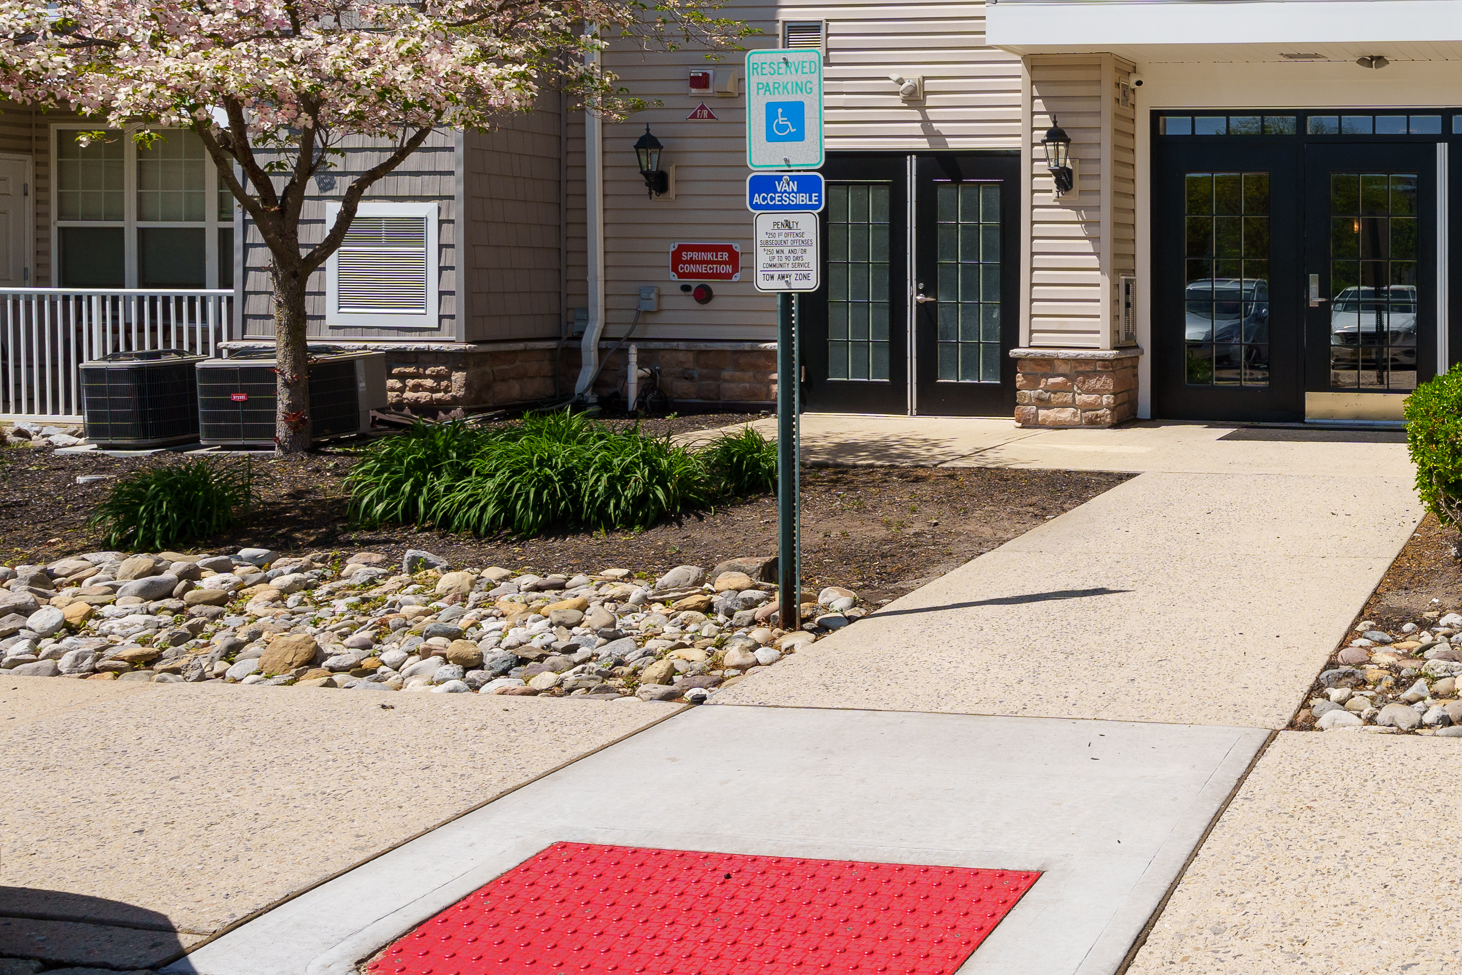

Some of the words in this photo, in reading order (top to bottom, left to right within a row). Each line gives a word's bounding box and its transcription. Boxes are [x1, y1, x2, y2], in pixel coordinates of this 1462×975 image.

[751, 60, 817, 76] RESERVED
[756, 80, 813, 96] PARKING
[696, 109, 709, 119] F/R
[775, 180, 797, 193] VAN
[752, 192, 819, 205] ACCESSIBLE
[772, 221, 799, 229] PENALTY
[765, 231, 776, 239] $250
[784, 231, 806, 239] OFFENSE
[681, 251, 730, 261] SPRINKLER
[787, 248, 808, 256] AND/OR
[678, 264, 733, 274] CONNECTION
[791, 261, 811, 269] SERVICE
[762, 273, 775, 282] TOW
[777, 273, 792, 281] AWAY
[794, 272, 812, 281] ZONE
